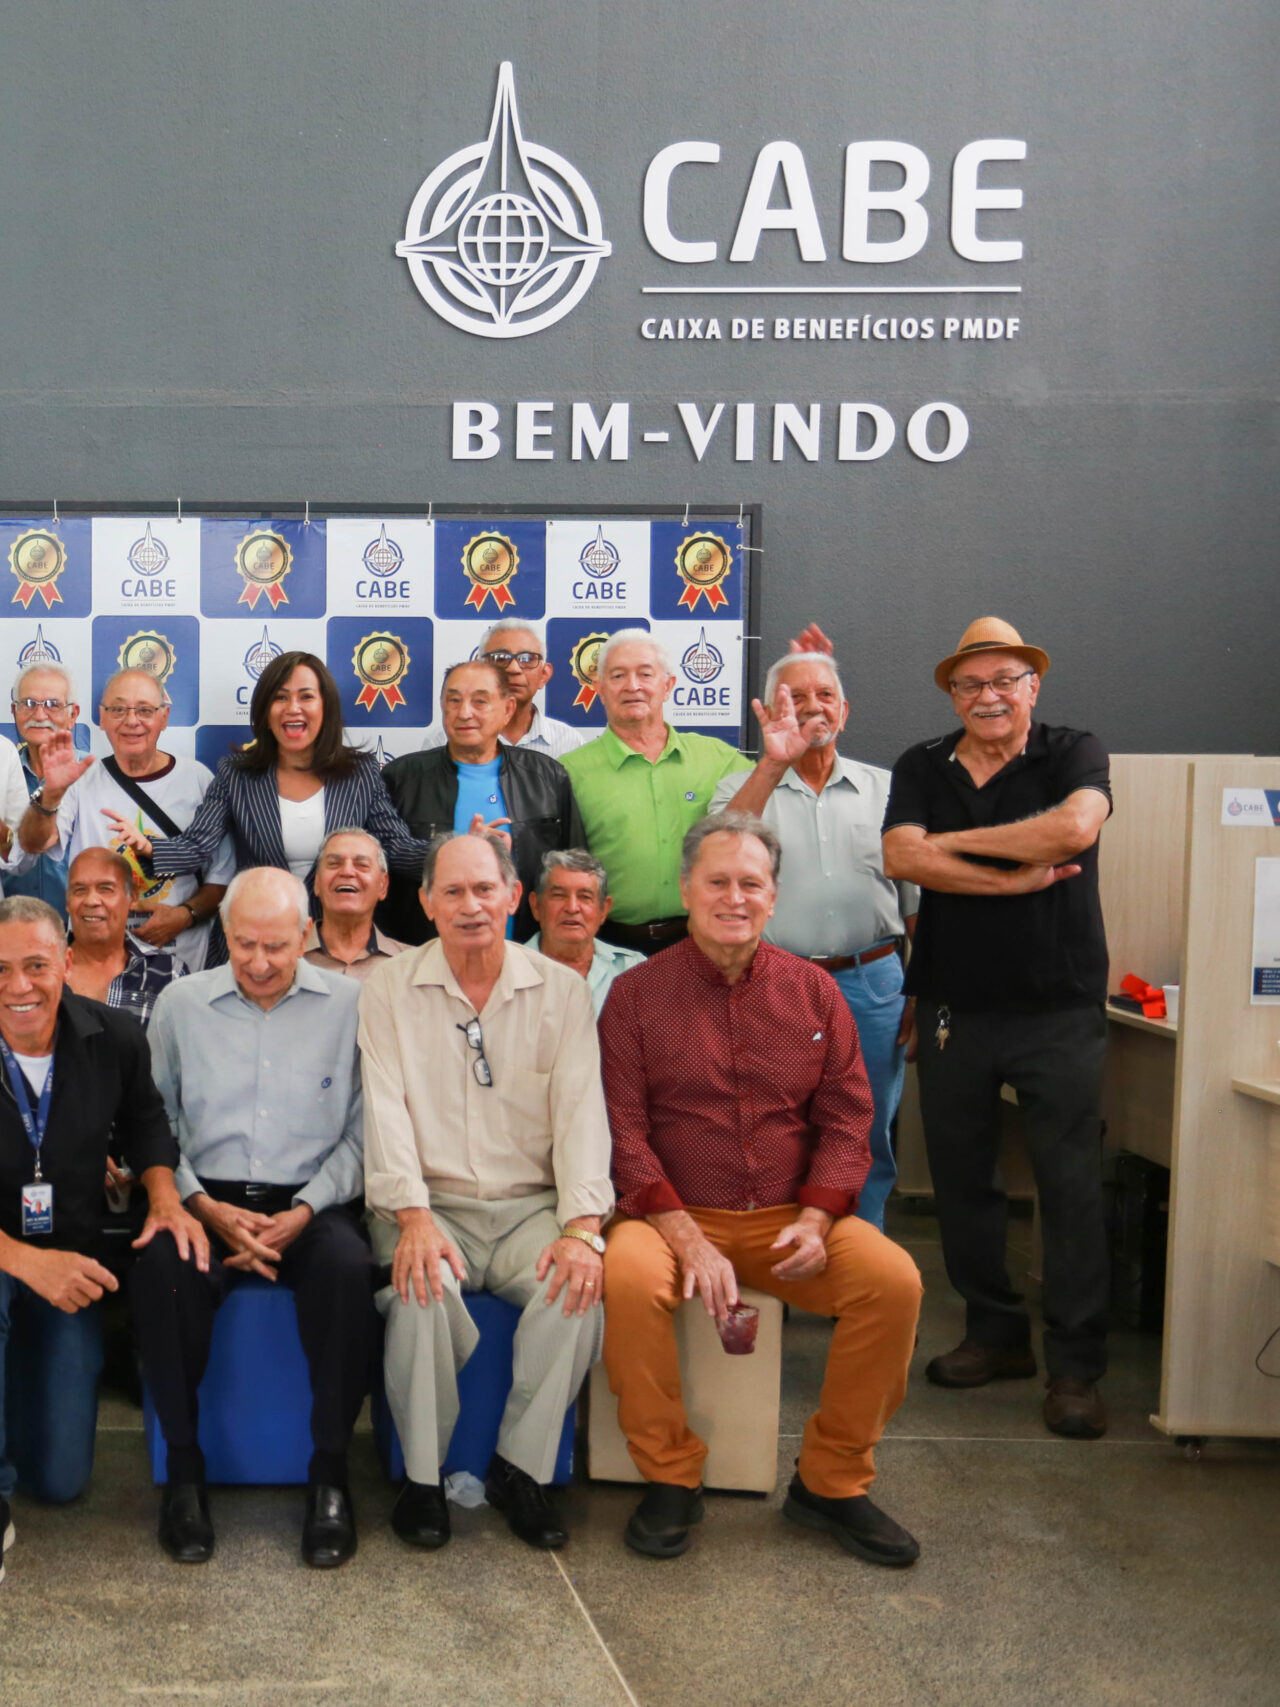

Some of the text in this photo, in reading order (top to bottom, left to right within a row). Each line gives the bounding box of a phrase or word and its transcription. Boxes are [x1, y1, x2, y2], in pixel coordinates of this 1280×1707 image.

[643, 139, 1026, 263] CABE
[641, 314, 1020, 340] CAIXA DE BENEFÍCIOS PMDF
[451, 401, 969, 462] BEM-VINDO
[27, 561, 49, 569] CABE
[253, 562, 275, 570] CABE
[480, 564, 502, 572] CABE
[693, 564, 715, 572] CABE
[121, 579, 176, 598] CABE
[356, 580, 410, 599] CABE
[572, 581, 627, 600] CABE
[370, 664, 392, 672] CABE
[673, 687, 730, 706] CABE
